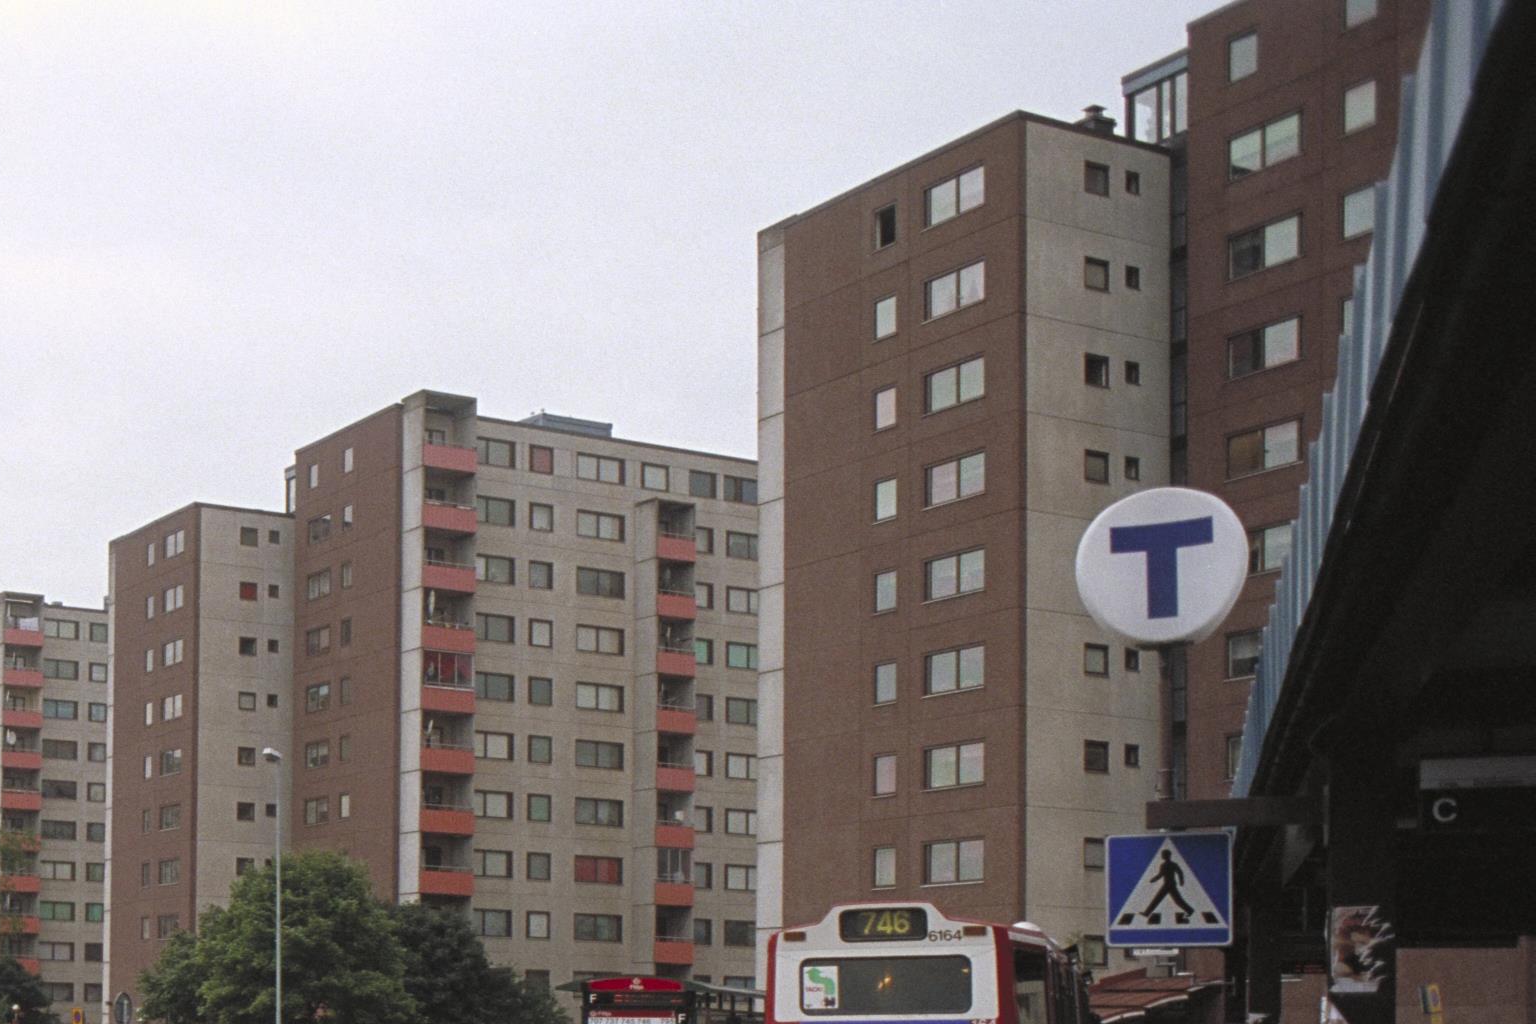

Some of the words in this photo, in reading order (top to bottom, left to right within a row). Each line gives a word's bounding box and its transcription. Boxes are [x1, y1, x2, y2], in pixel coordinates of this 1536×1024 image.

[1110, 516, 1213, 619] T
[1433, 798, 1457, 822] C
[861, 910, 911, 935] 746
[928, 930, 962, 942] 6164
[589, 994, 597, 1003] F
[678, 1014, 686, 1024] F
